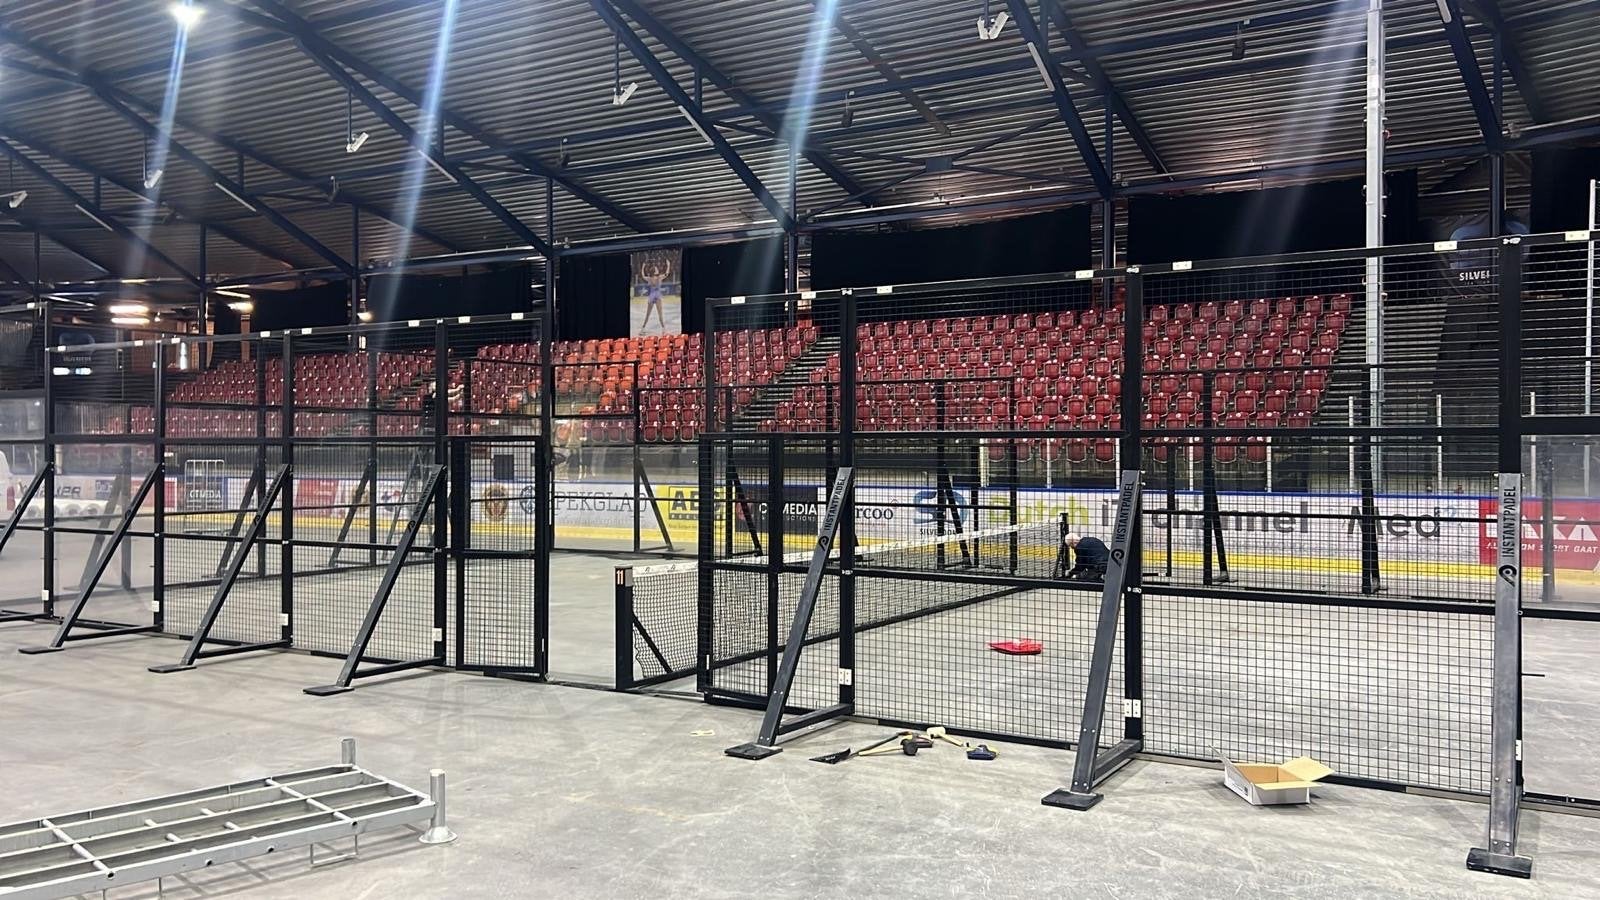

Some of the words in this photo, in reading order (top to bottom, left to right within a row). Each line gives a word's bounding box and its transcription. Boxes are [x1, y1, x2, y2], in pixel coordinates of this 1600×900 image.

[550, 490, 647, 512] PEKGLAD
[824, 476, 847, 531] INSTANTPADEL
[854, 507, 894, 520] rcoo
[1115, 481, 1135, 543] INSTANTPADEL
[1502, 486, 1516, 557] INSTANTPADEL
